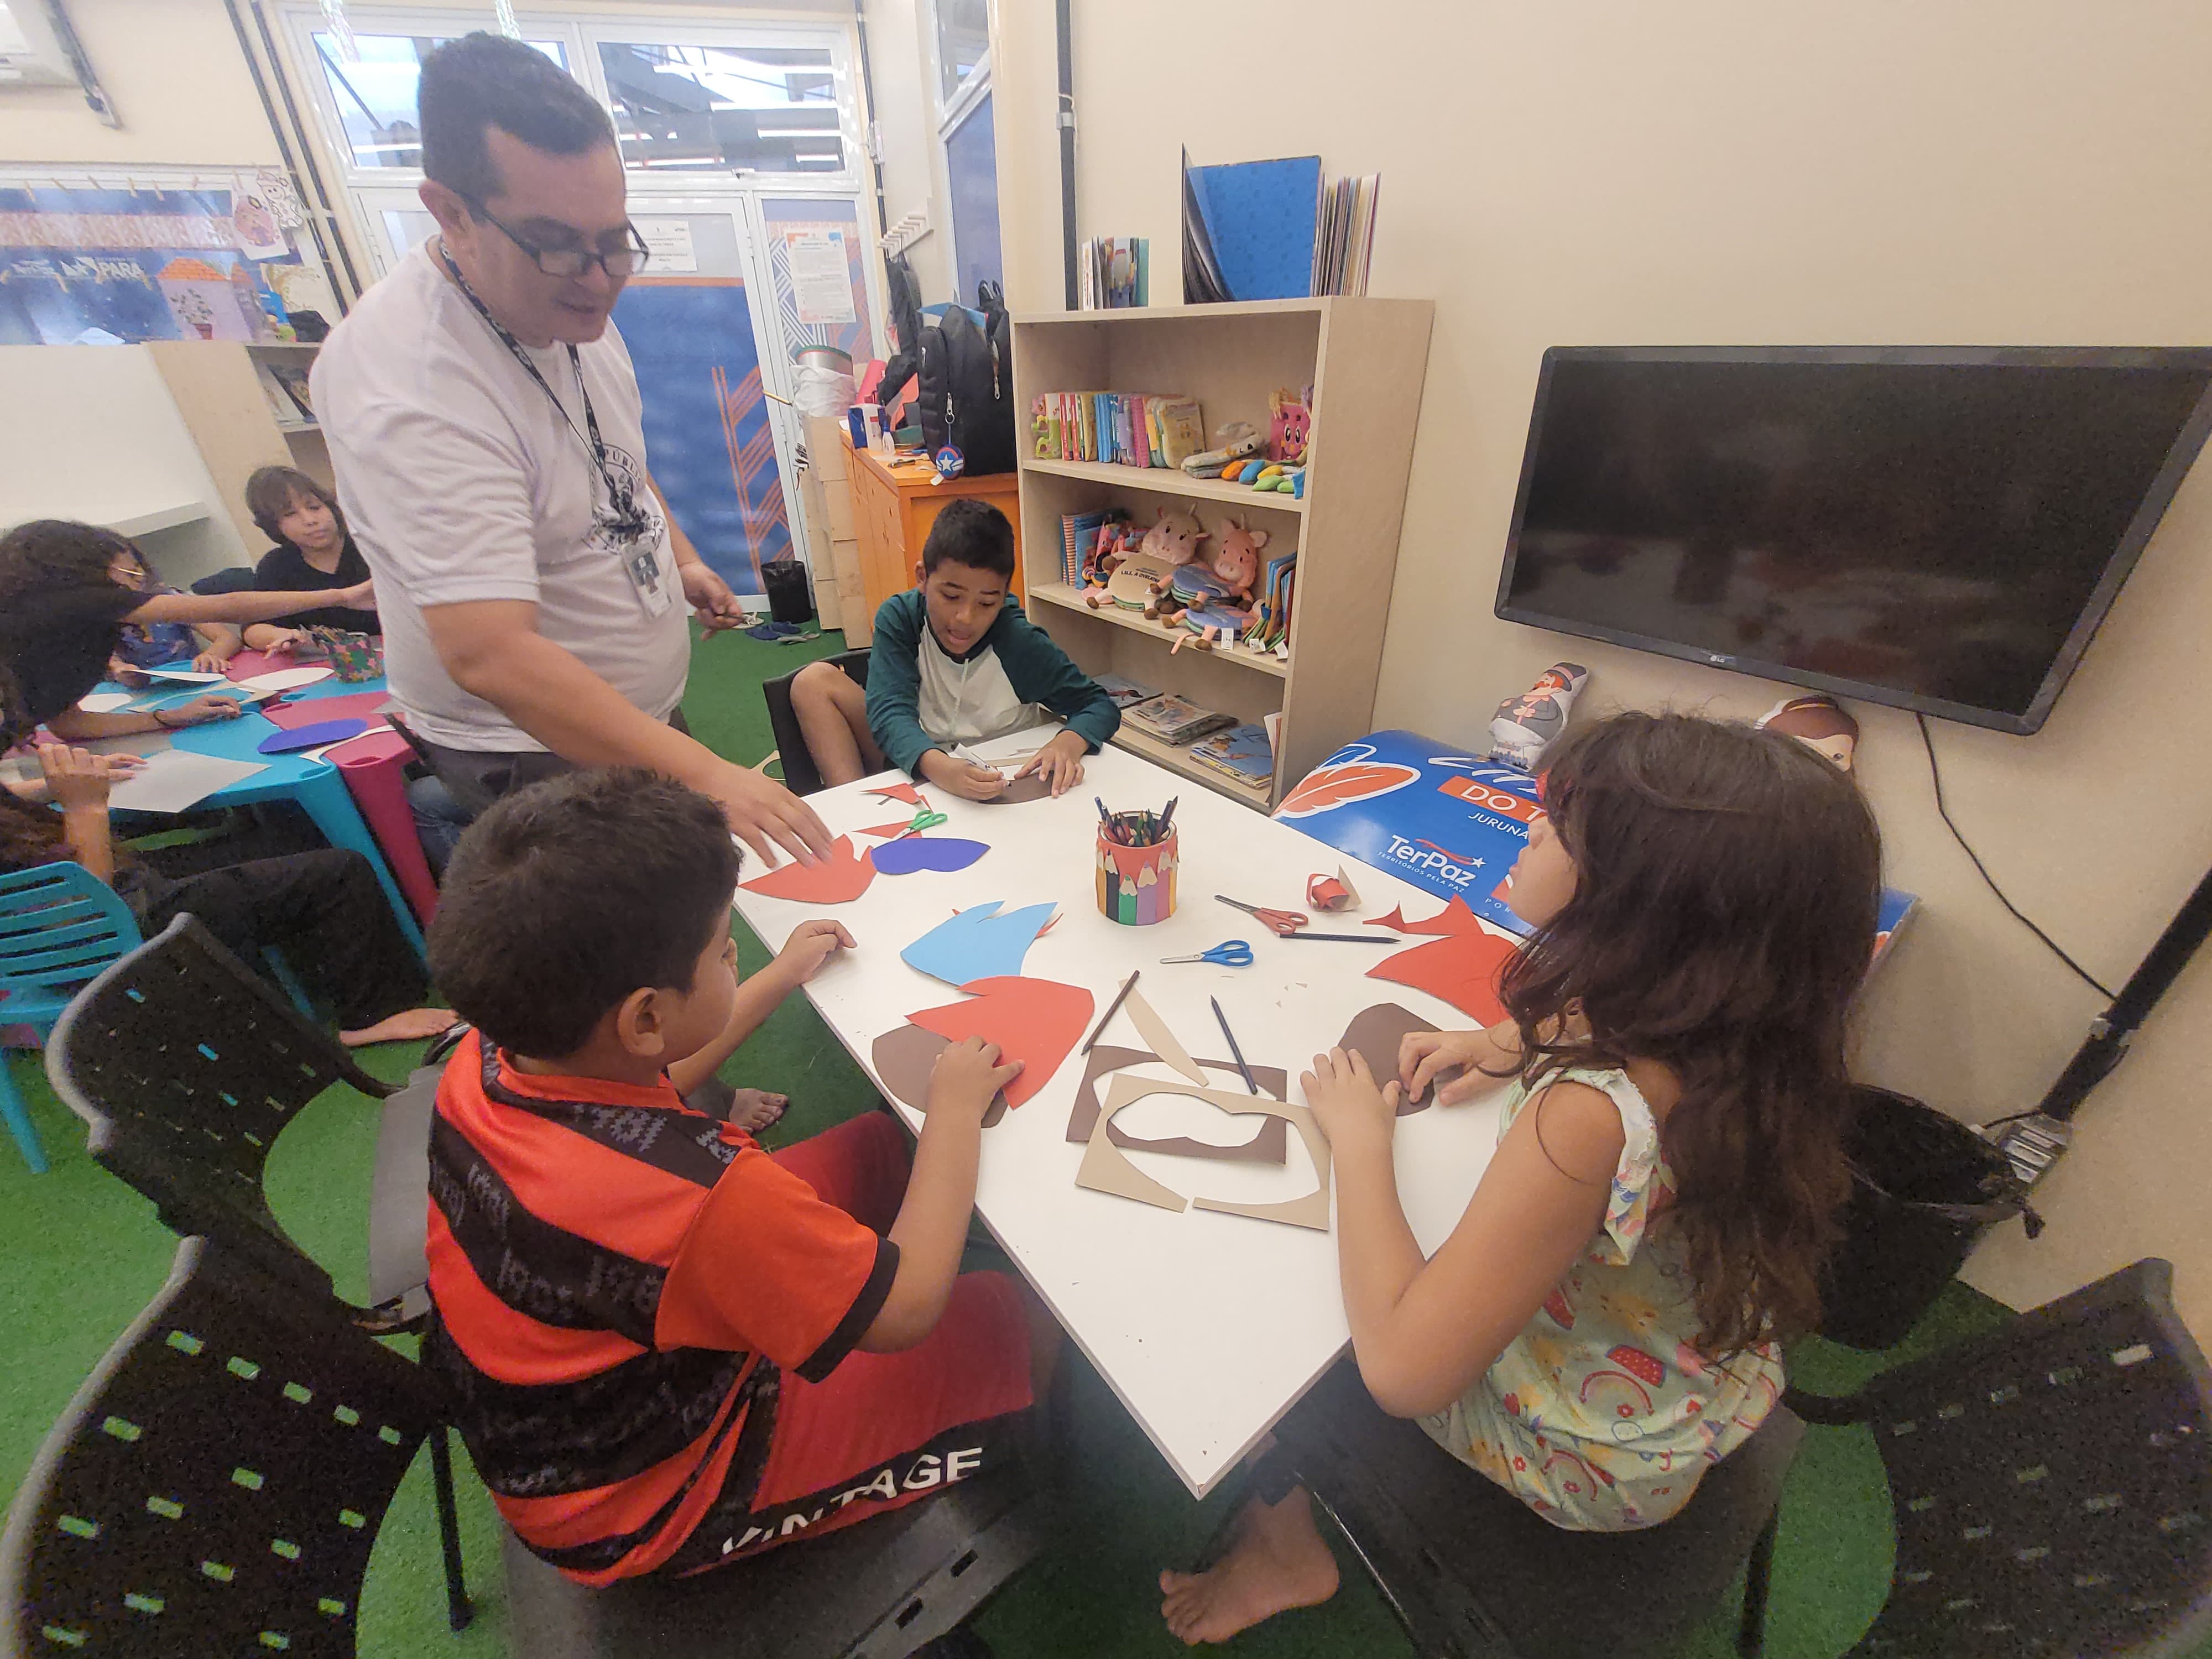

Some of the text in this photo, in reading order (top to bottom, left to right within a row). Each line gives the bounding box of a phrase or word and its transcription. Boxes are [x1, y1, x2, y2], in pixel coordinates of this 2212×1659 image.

[1460, 785, 1547, 821] DO T
[1468, 812, 1528, 839] JURUNA
[1387, 834, 1477, 887] TerPaz
[1426, 873, 1446, 885] PELA
[1448, 883, 1465, 894] PAZ
